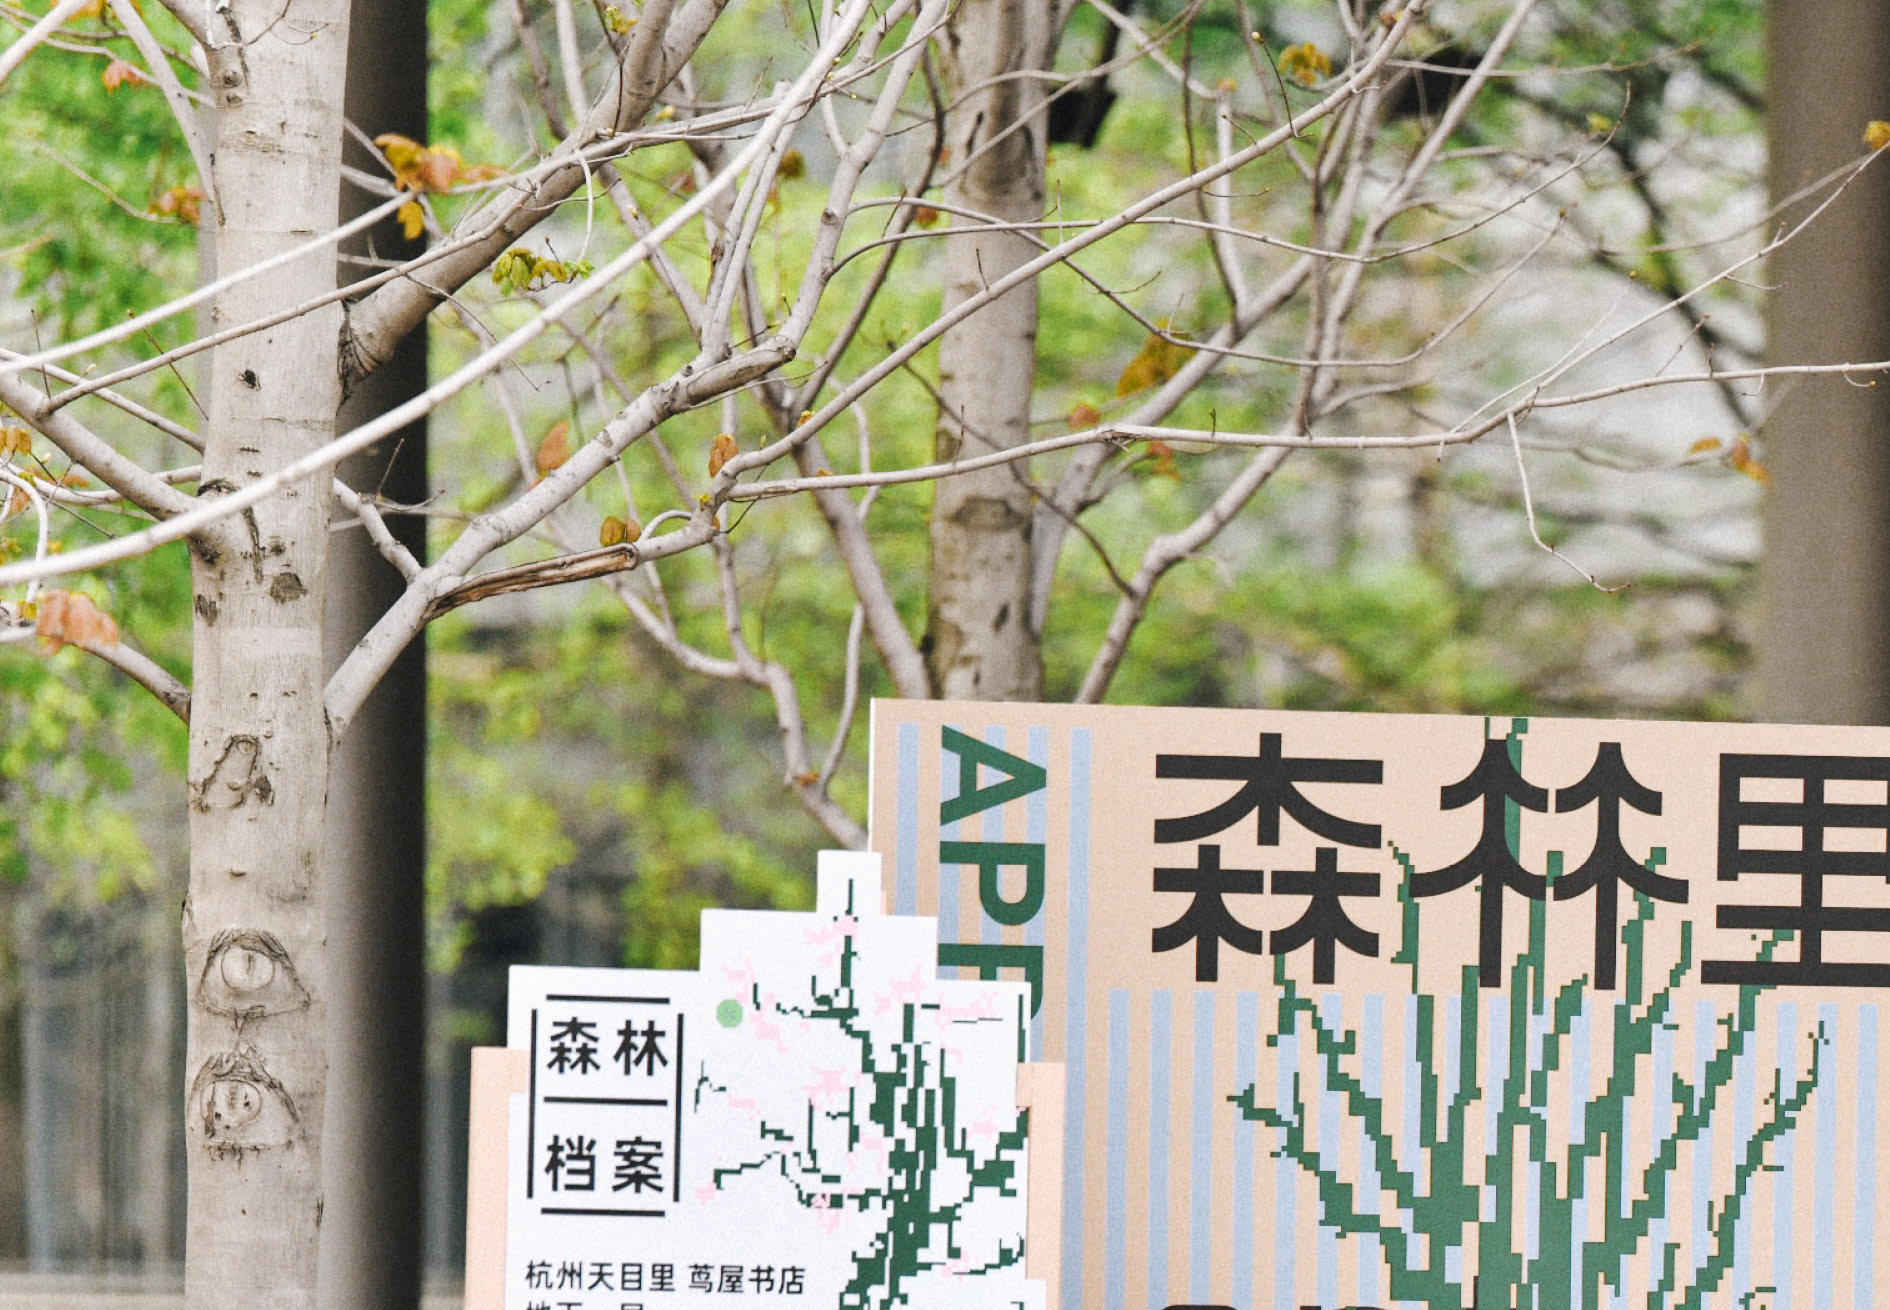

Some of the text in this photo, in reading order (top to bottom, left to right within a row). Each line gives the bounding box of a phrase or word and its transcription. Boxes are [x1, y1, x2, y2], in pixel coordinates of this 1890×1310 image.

[547, 1017, 668, 1076] 森林
[545, 1135, 663, 1193] 档案
[526, 1261, 805, 1294] 杭州天目里 茑屋书店
